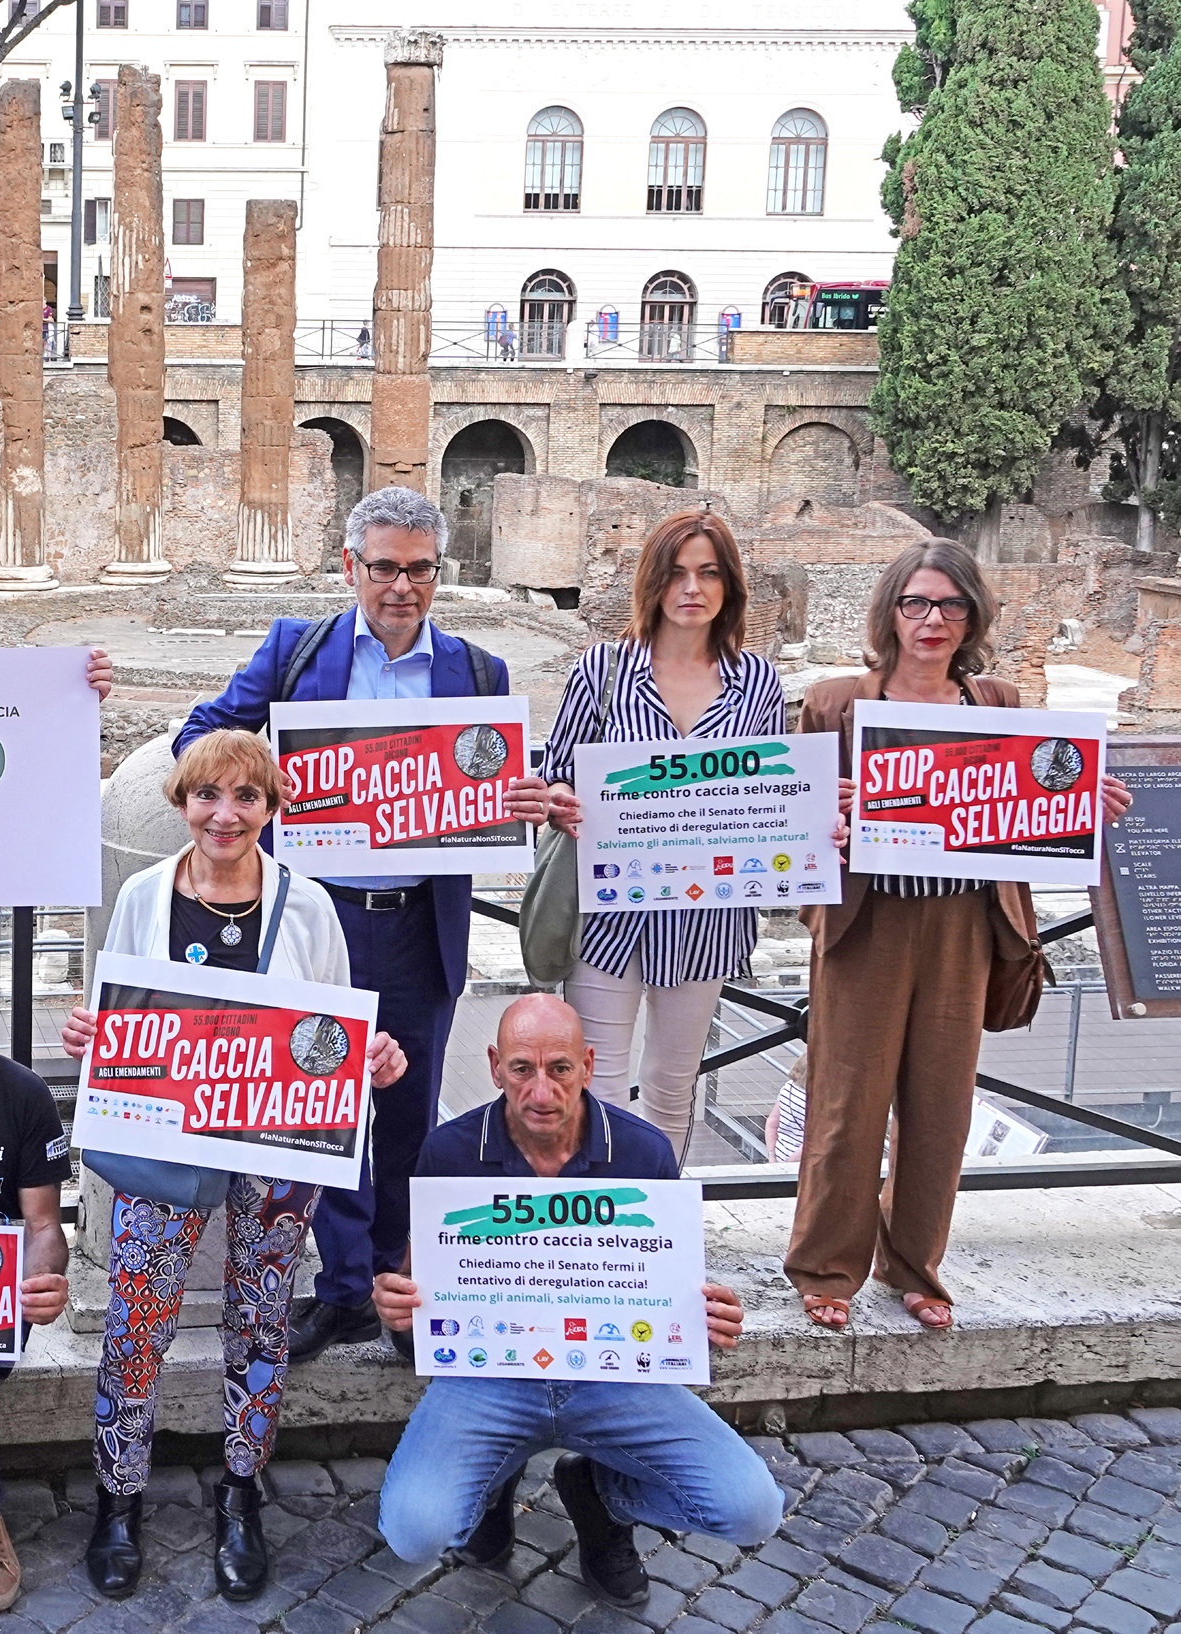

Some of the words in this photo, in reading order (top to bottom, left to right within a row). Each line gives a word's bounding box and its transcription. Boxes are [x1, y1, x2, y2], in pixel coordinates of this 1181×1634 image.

[287, 747, 354, 796] STOP
[649, 750, 759, 780] 55.000
[866, 749, 934, 794] STOP
[352, 752, 442, 805] CACCIA
[929, 761, 1017, 807] CACCIA
[600, 790, 639, 801] firme
[643, 788, 690, 799] contro
[695, 784, 738, 796] caccia
[744, 781, 810, 796] selvaggia
[288, 803, 301, 814] AGLI
[303, 796, 343, 810] EMENDAMENTI
[376, 777, 518, 844] SELVAGGI
[619, 810, 675, 820] Chiediamo
[677, 808, 696, 817] che
[699, 808, 705, 816] il
[708, 807, 744, 816] Senato
[747, 805, 775, 814] fermi
[779, 804, 785, 812] il
[617, 824, 666, 834] tentativo
[669, 823, 678, 832] di
[681, 821, 749, 833] deregulation
[752, 818, 787, 828] caccia!
[949, 792, 1092, 846] SELVAGGIA
[440, 834, 516, 845] #laNaturaNonSiTocca
[596, 840, 644, 849] Salviamo
[646, 838, 658, 849] gli
[661, 836, 704, 846] animali,
[707, 835, 754, 844] salviamo
[757, 834, 767, 842] la
[770, 832, 808, 841] natura!
[1011, 845, 1084, 854] #laNaturaNonSiTocca
[100, 1014, 181, 1059] STOP
[171, 1037, 272, 1080] CACCIA
[99, 1067, 113, 1077] AGLI
[115, 1066, 161, 1077] EMENDAMENTI
[190, 1079, 355, 1128] SELVAGGIA
[260, 1132, 344, 1152] #laNaturaNonSiTocca
[492, 1194, 614, 1225] 55.000
[438, 1231, 481, 1244] firme
[485, 1234, 538, 1245] contro
[543, 1233, 591, 1246] caccia
[597, 1234, 672, 1252] selvaggia
[459, 1258, 520, 1269] Chiediamo
[524, 1259, 544, 1269] che
[548, 1259, 554, 1269] il
[558, 1260, 598, 1270] Senato
[602, 1260, 634, 1271] fermi
[638, 1262, 644, 1271] il
[457, 1275, 511, 1285] tentativo
[514, 1276, 525, 1285] di
[528, 1276, 604, 1289] deregulation
[607, 1279, 647, 1289] caccia!
[434, 1291, 486, 1301] Salviamo
[489, 1292, 502, 1304] gli
[506, 1292, 553, 1304] animali,
[557, 1293, 610, 1304] salviamo
[614, 1295, 624, 1305] la
[628, 1297, 672, 1306] natura!
